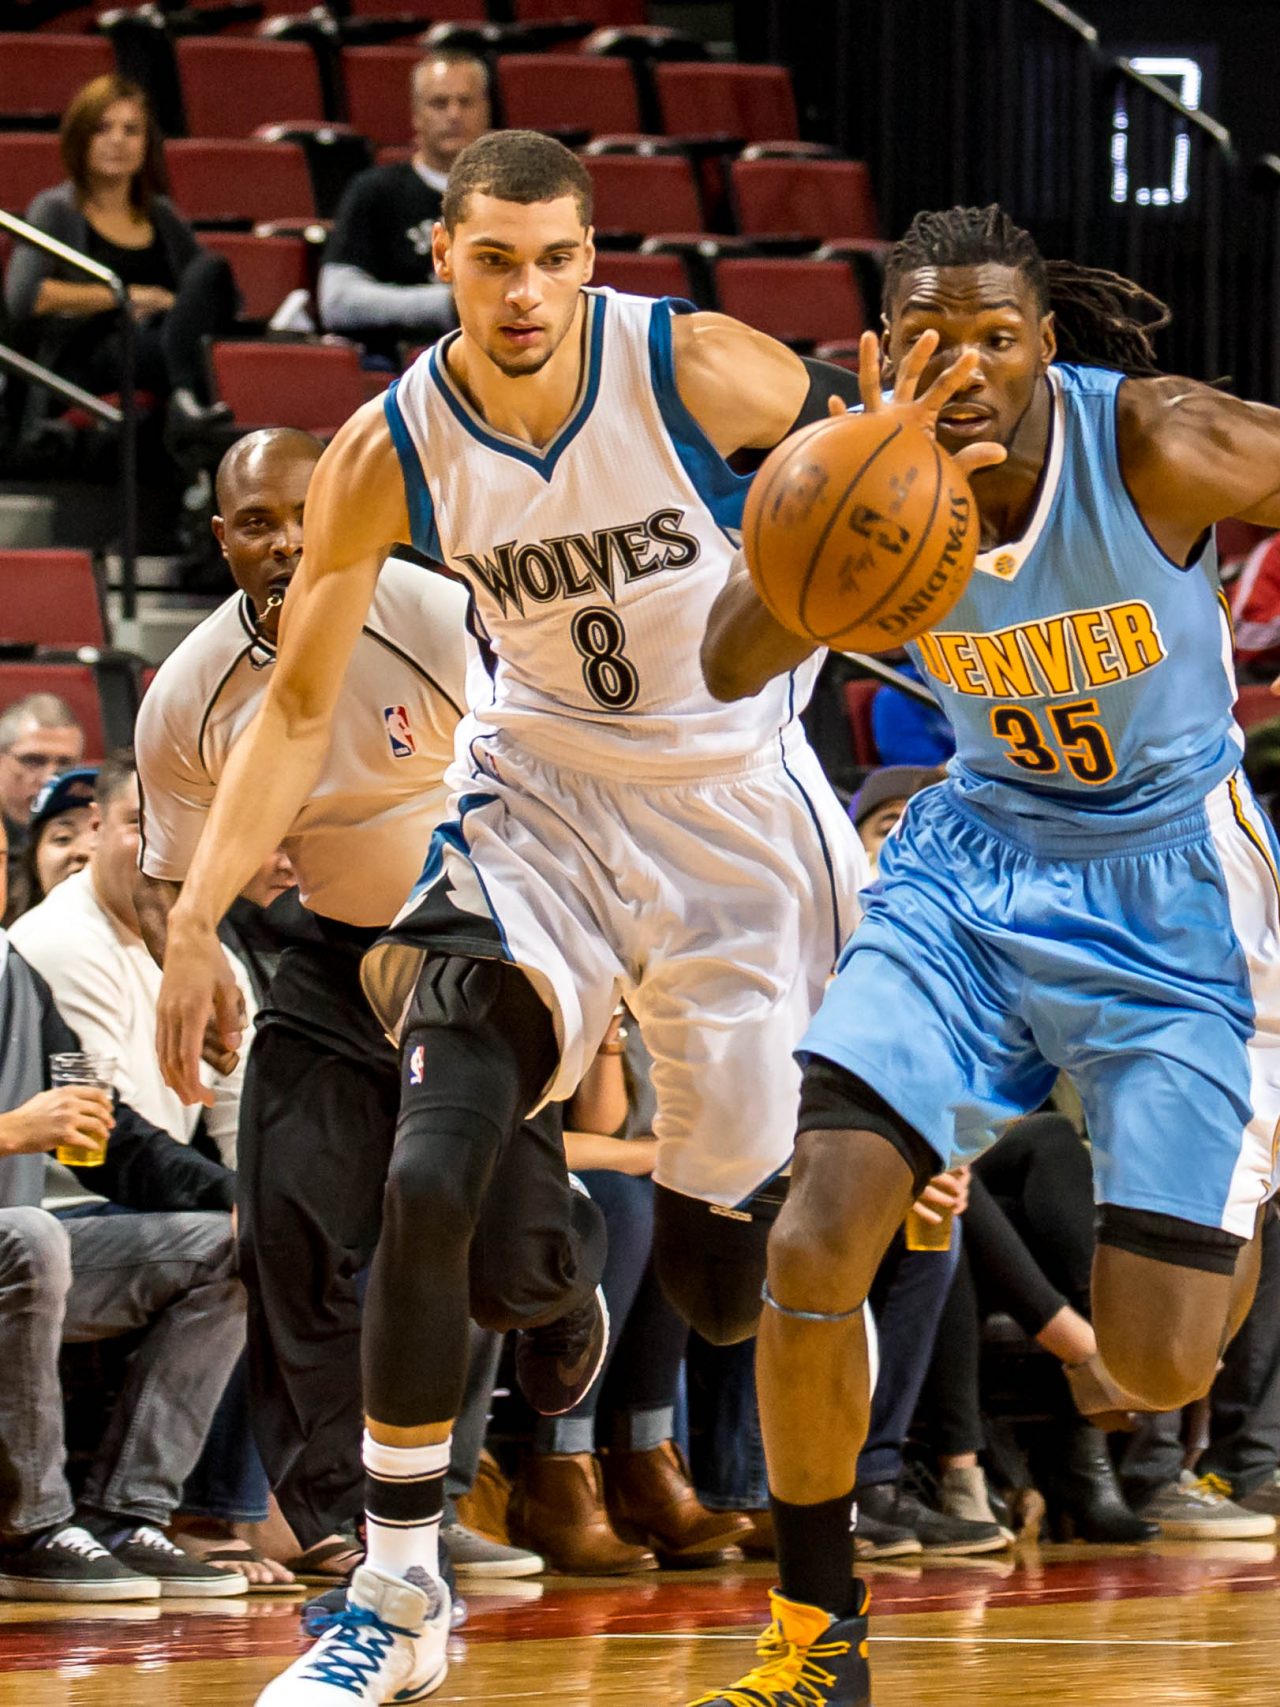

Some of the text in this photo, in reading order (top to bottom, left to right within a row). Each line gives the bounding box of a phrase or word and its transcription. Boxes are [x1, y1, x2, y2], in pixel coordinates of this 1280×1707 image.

[453, 508, 701, 619] WOLVES
[570, 605, 640, 711] 8
[990, 698, 1118, 785] 35
